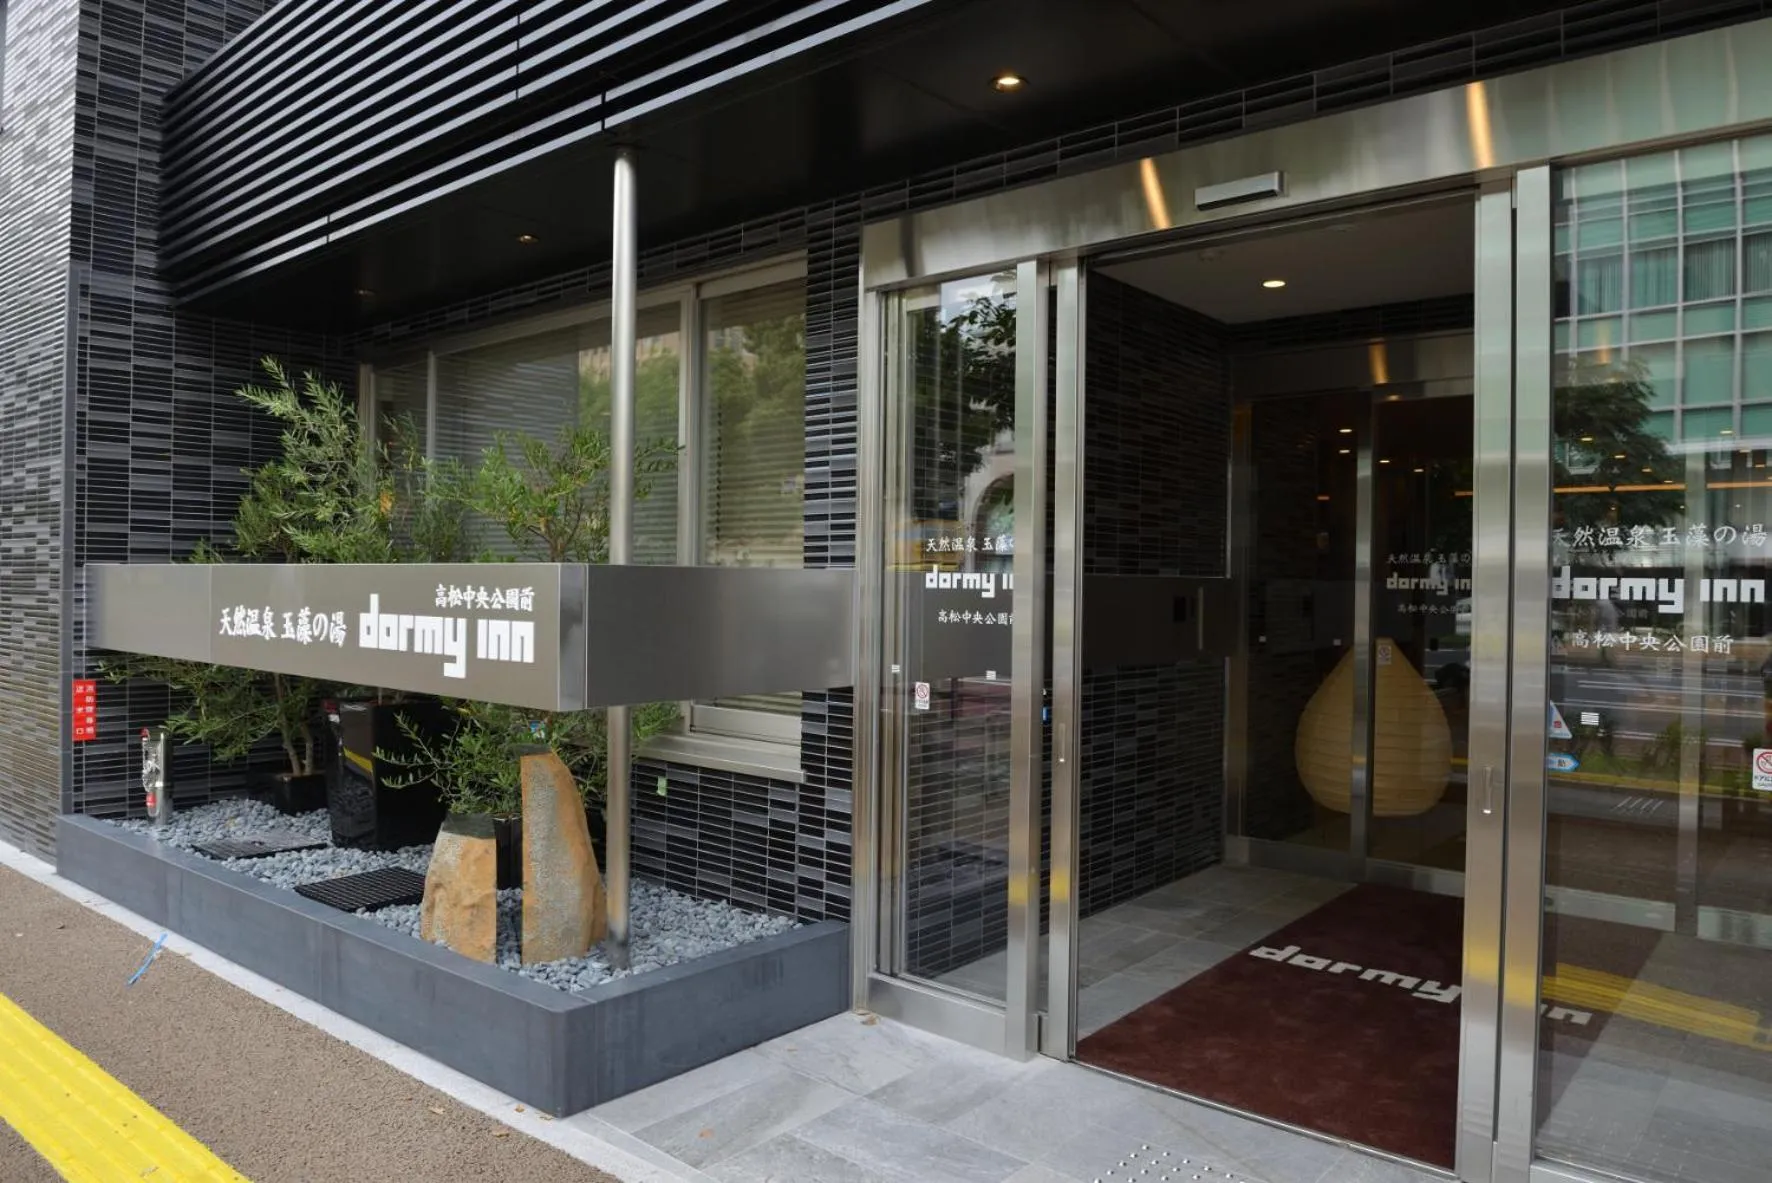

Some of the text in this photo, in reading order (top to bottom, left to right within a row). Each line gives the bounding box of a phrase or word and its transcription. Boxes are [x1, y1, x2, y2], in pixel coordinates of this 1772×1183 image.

[435, 583, 535, 612] 高松中央公園前
[926, 564, 995, 598] dormy
[1386, 571, 1448, 596] dormy
[1552, 565, 1765, 614] dormy inn
[219, 604, 347, 648] 天然温泉 玉藻の湯
[359, 593, 535, 679] dormy inn
[1571, 629, 1735, 654] 高松中央公園前
[1249, 945, 1462, 1004] dormy
